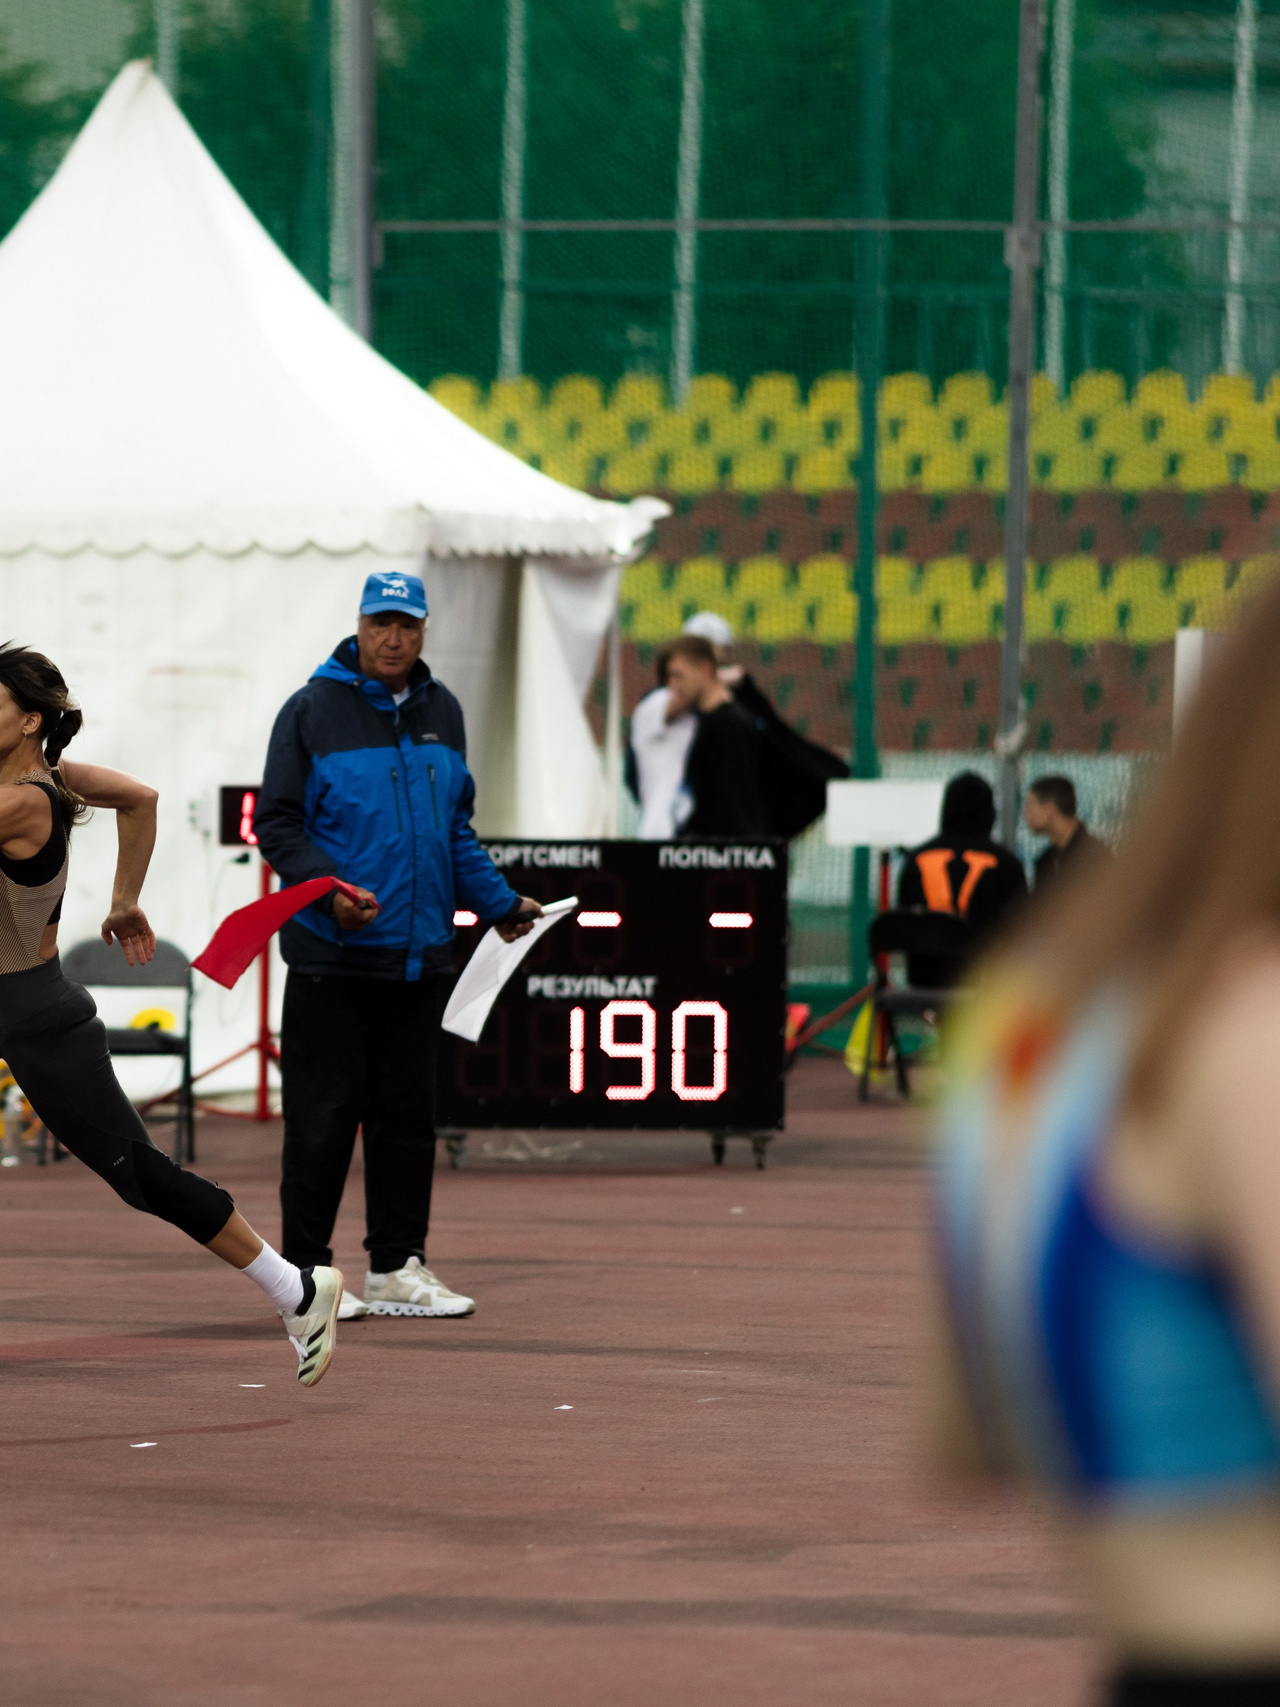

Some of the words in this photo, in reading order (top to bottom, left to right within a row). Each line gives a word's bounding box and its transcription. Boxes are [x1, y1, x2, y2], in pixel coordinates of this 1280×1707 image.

[482, 845, 601, 868] ОРТСМЕН
[659, 846, 775, 868] ПОПЫТКА
[916, 849, 998, 919] V
[527, 975, 657, 997] РЕЗУЛЬТАТ
[569, 1000, 727, 1100] 190
